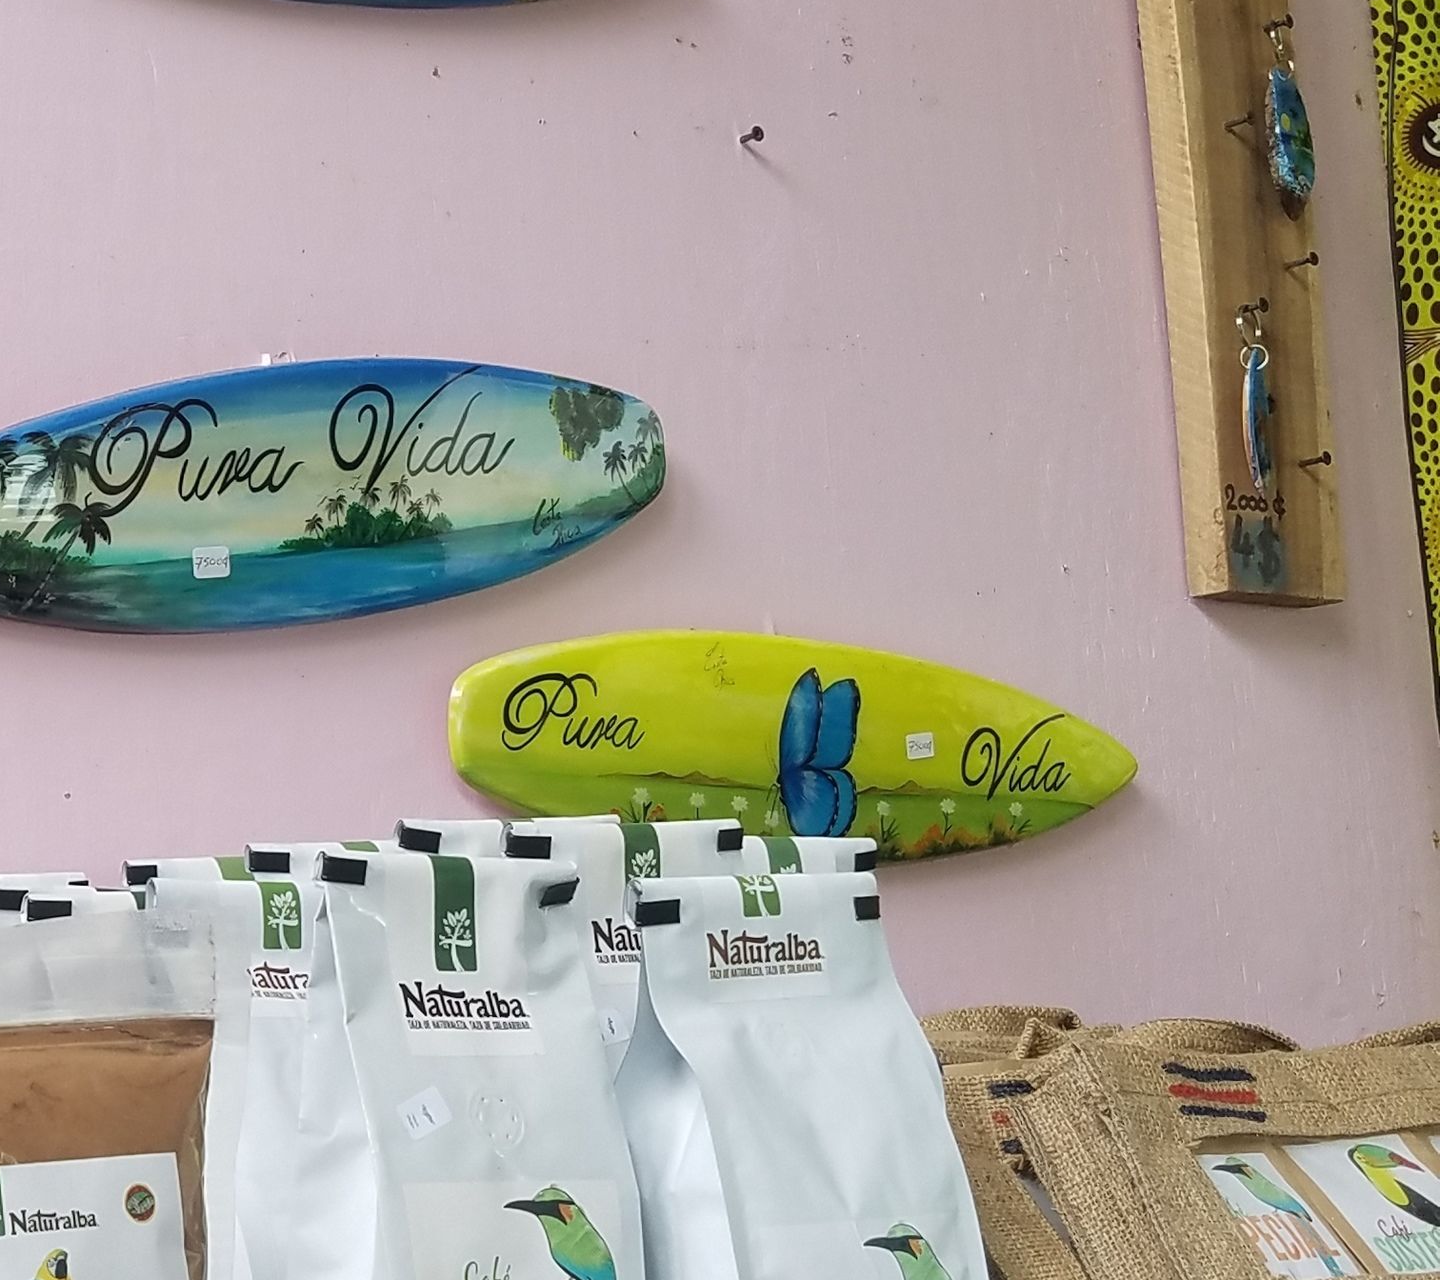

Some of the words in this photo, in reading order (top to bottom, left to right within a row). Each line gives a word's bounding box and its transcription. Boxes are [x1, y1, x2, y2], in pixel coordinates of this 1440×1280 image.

[90, 398, 307, 517] Pura
[329, 365, 516, 496] Vida
[500, 671, 647, 752] Pura
[959, 713, 1074, 801] Vida
[706, 929, 823, 968] Naturalba
[248, 961, 310, 990] atura
[398, 981, 527, 1019] Naturalba
[9, 1208, 98, 1236] Naturalba
